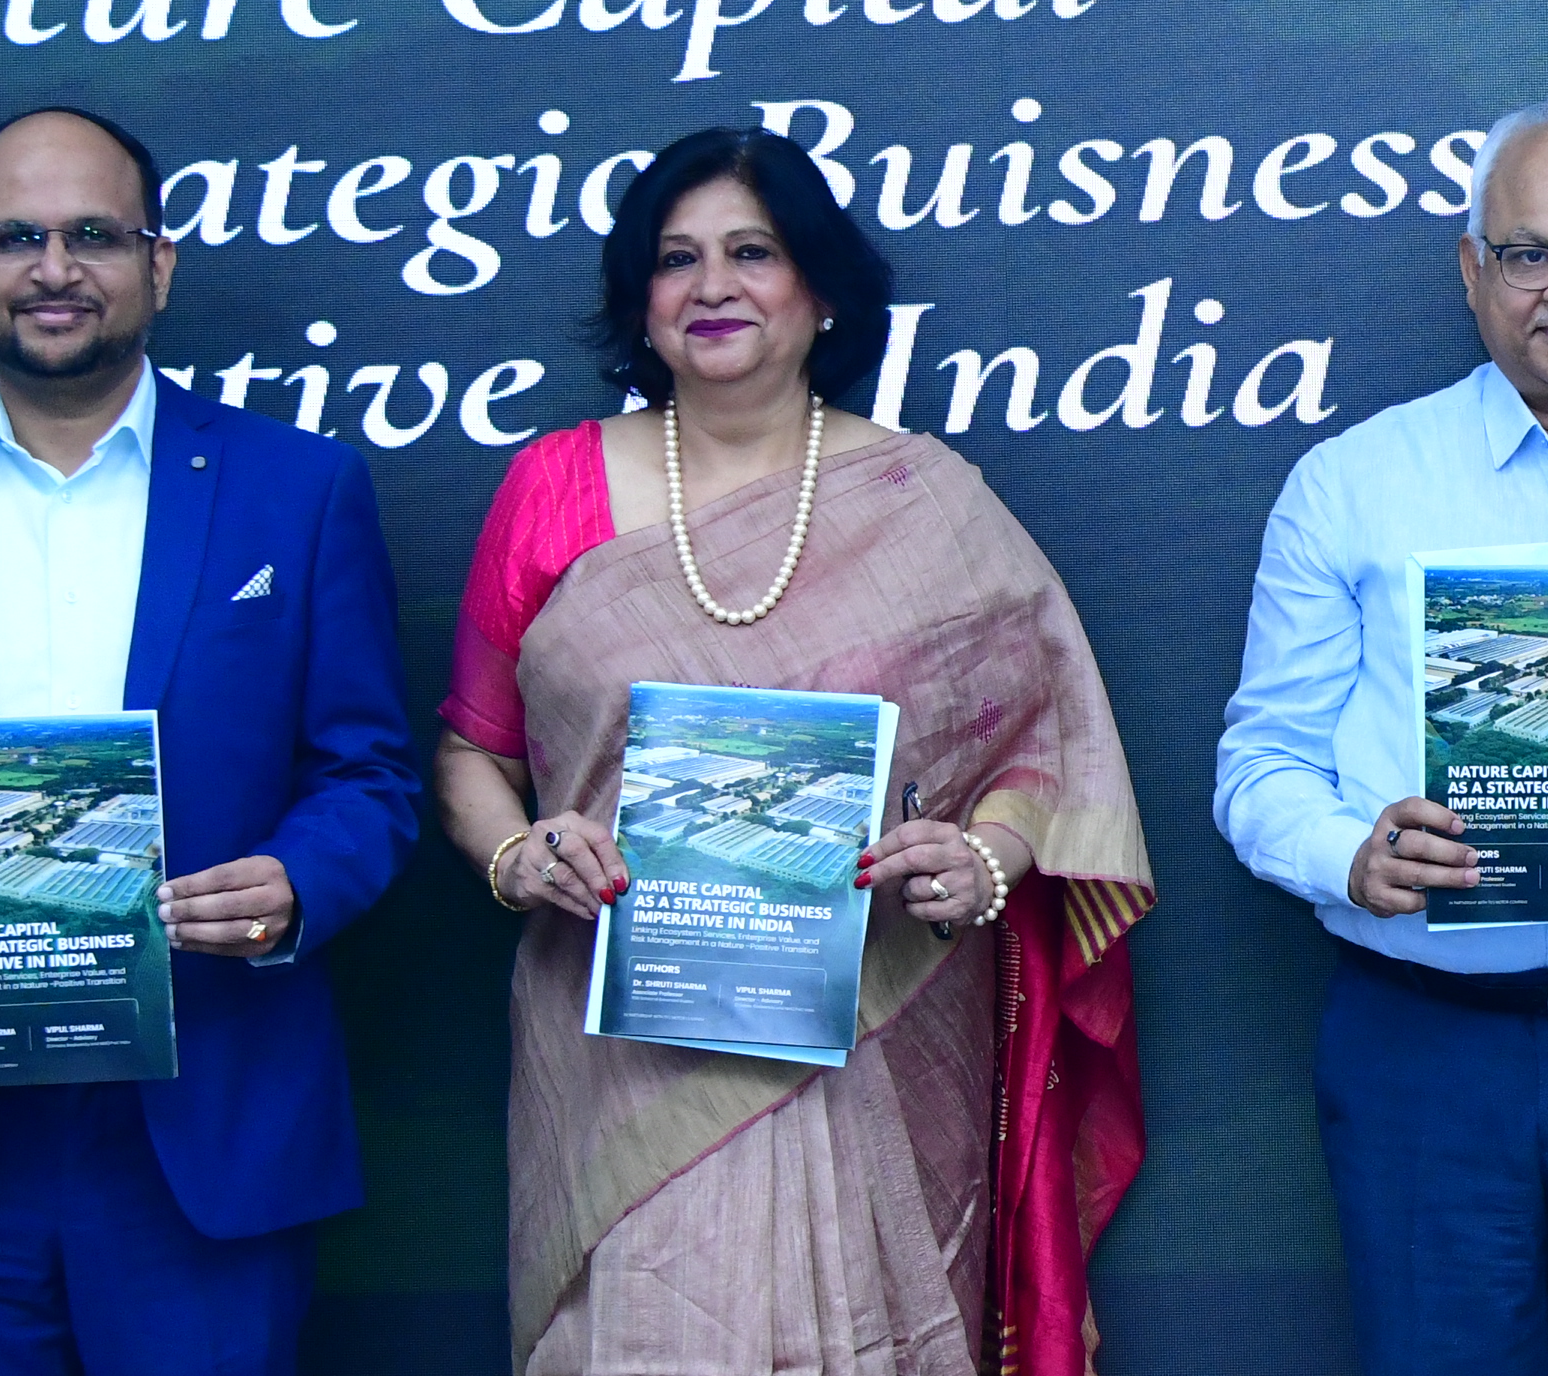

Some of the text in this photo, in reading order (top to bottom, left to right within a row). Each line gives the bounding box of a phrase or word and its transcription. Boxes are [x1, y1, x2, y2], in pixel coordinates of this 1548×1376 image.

[867, 276, 1339, 435] India
[1448, 766, 1508, 778] NATURE
[1447, 782, 1468, 794] AS
[1471, 782, 1483, 794] A
[1448, 797, 1538, 810] IMPERATIVE
[1475, 813, 1517, 822] Ecosystem
[636, 880, 765, 899] NATURE CAPITAL
[634, 895, 833, 919] AS A STRATEGIC BUSINESS
[633, 911, 794, 932] IMPERATIVE IN INDIA
[57, 934, 135, 950] BUSINESS
[631, 926, 658, 935] Linking
[659, 929, 701, 938] Ecosystem
[738, 934, 777, 943] Enterprise
[646, 937, 700, 948] Management
[718, 941, 744, 949] Nature
[781, 946, 819, 954] Transition
[28, 955, 45, 968] IN
[51, 953, 97, 967] INDIA
[634, 964, 681, 974] AUTHORS
[673, 982, 707, 990] SHARMA
[758, 988, 792, 996] SHARMA
